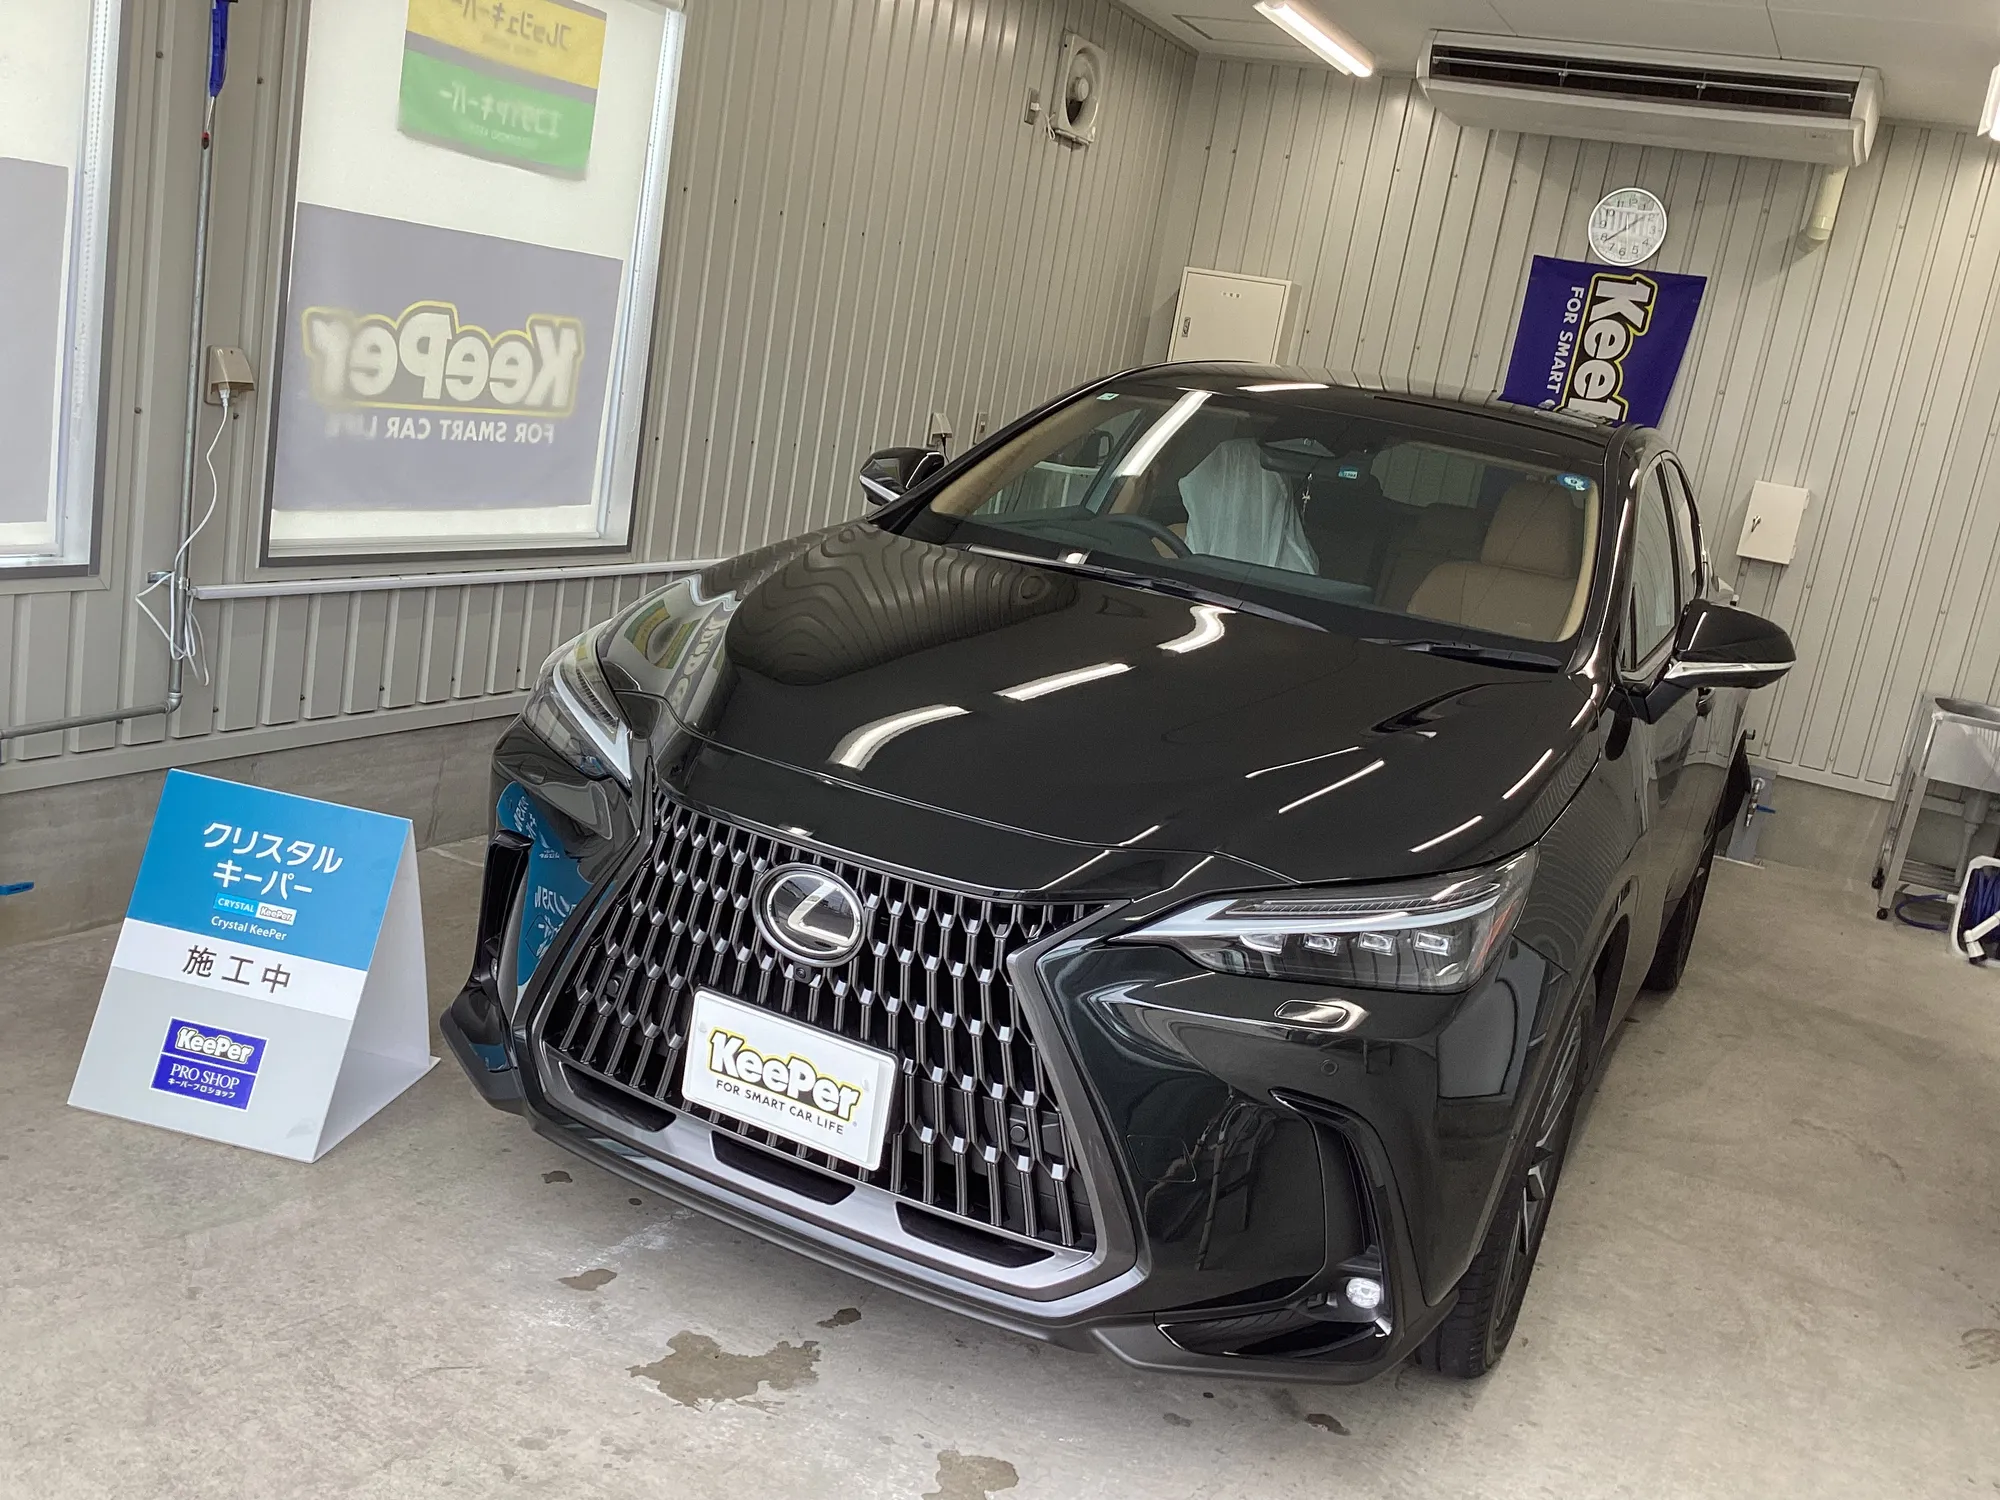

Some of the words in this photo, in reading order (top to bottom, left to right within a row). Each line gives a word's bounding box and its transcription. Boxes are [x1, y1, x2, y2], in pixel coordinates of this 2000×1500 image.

[1562, 286, 1585, 325] FOR
[1546, 330, 1575, 394] SMART
[203, 822, 344, 874] クリスタル
[213, 859, 313, 900] キーパー
[211, 915, 248, 933] Crystal
[249, 924, 288, 941] KeePer
[217, 897, 255, 913] CRYSTAL
[260, 906, 293, 921] KeePer
[182, 944, 292, 994] 施工中
[176, 1026, 254, 1064] KeePer
[167, 1077, 236, 1099] キーパープロショップ
[169, 1063, 200, 1081] PRO
[200, 1070, 240, 1090] SHOP
[709, 1029, 862, 1122] KeePer
[716, 1079, 740, 1097] FOR
[744, 1089, 786, 1112] SMART
[789, 1105, 813, 1123] CAR
[816, 1115, 844, 1135] LIFE
